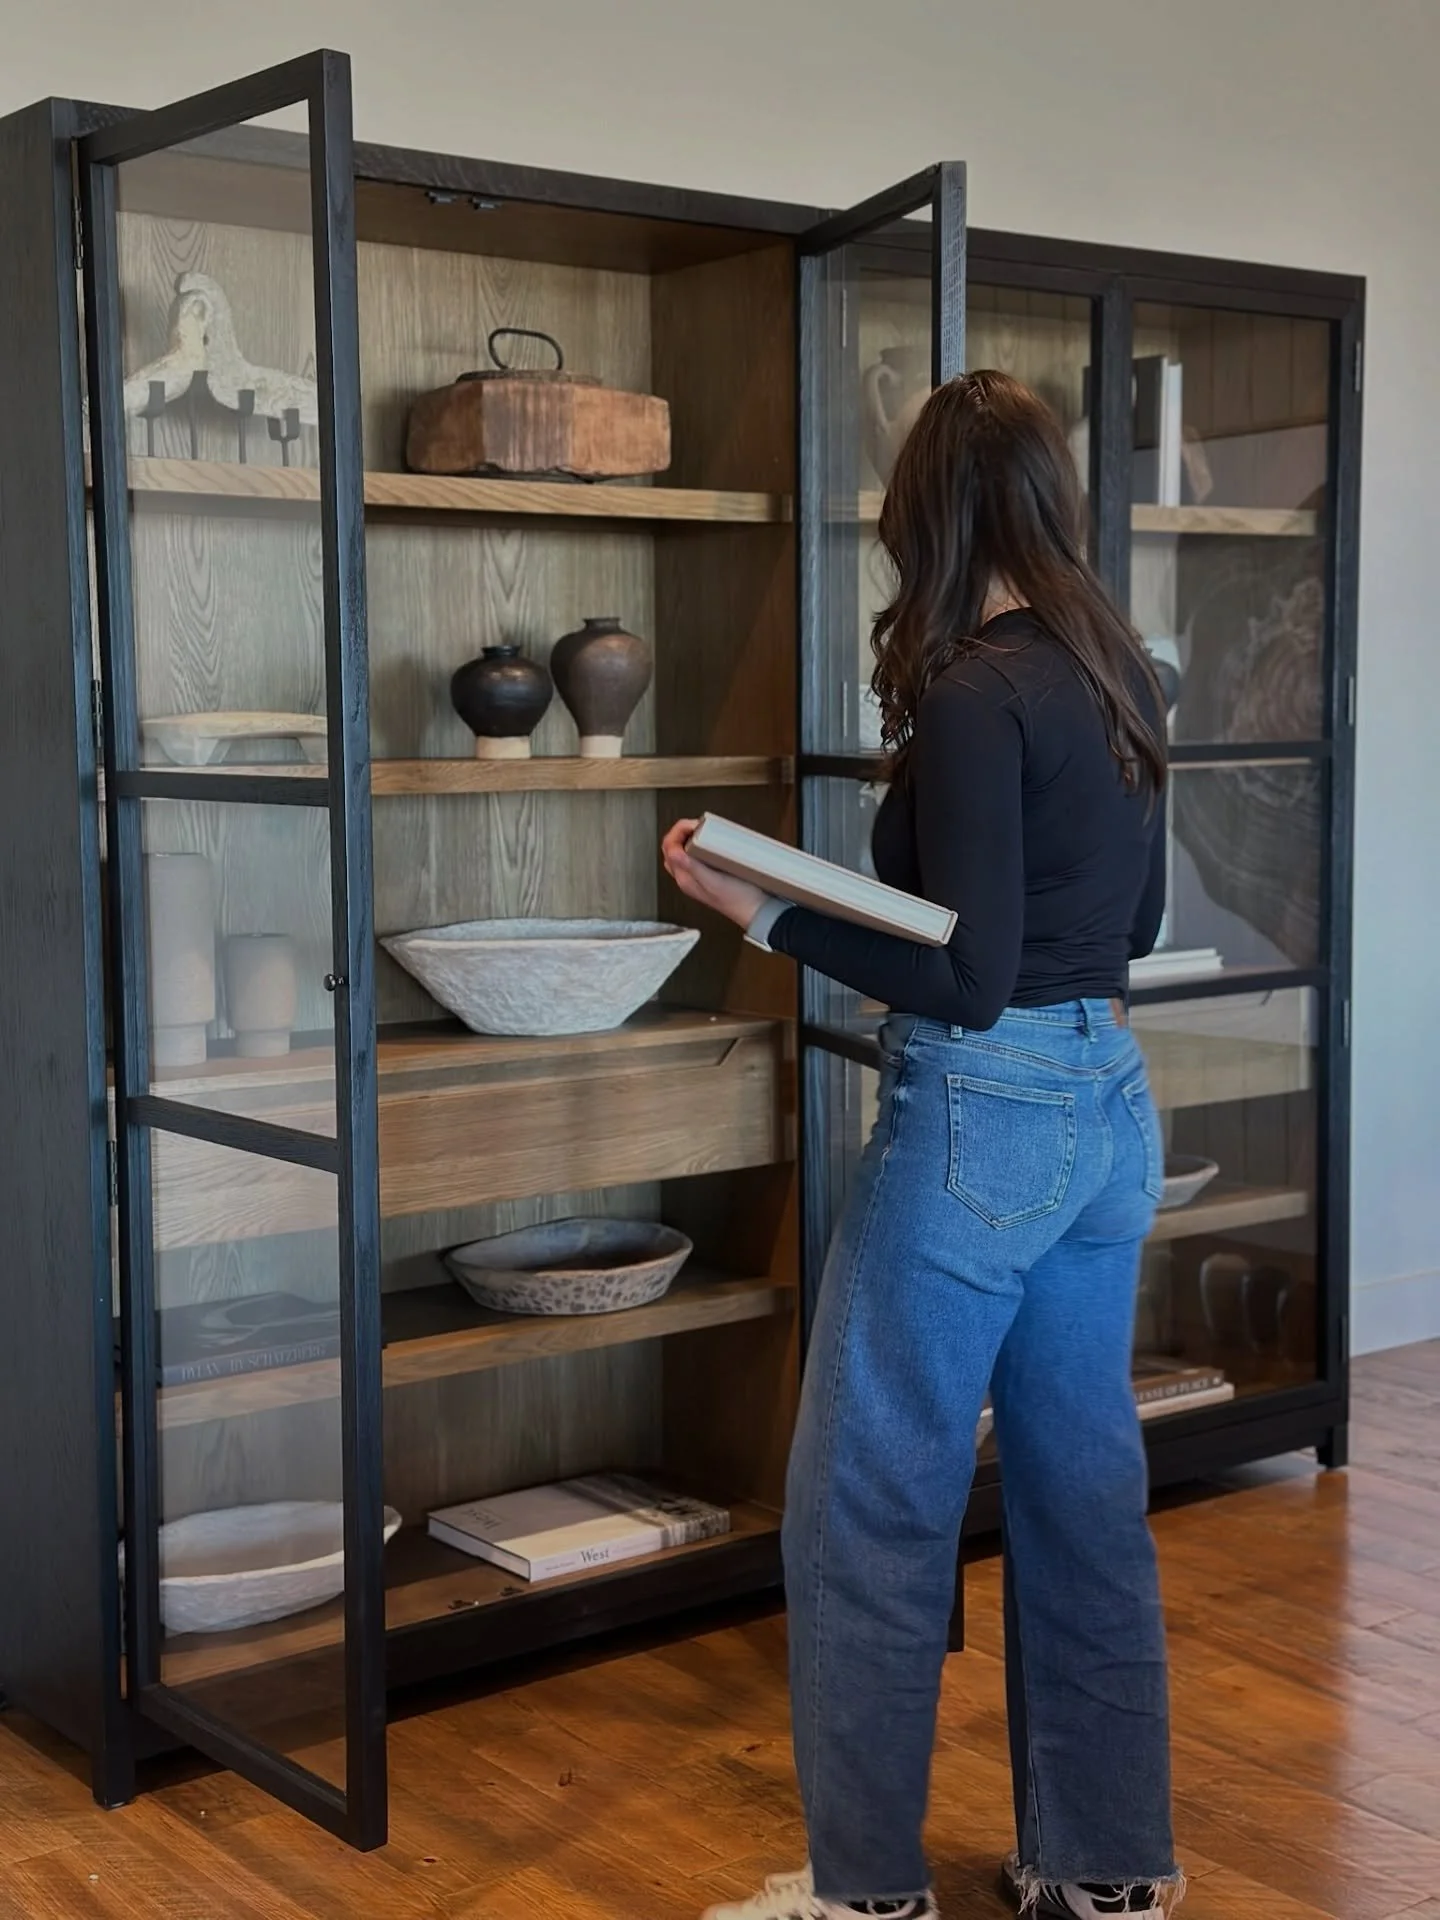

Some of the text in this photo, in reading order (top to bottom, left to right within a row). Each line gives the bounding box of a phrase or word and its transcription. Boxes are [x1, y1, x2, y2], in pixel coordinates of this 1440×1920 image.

[181, 1362, 220, 1381] DYLAN
[248, 1343, 327, 1369] SCHATZBERG
[1179, 1377, 1209, 1393] PLACE
[580, 1547, 610, 1563] West
